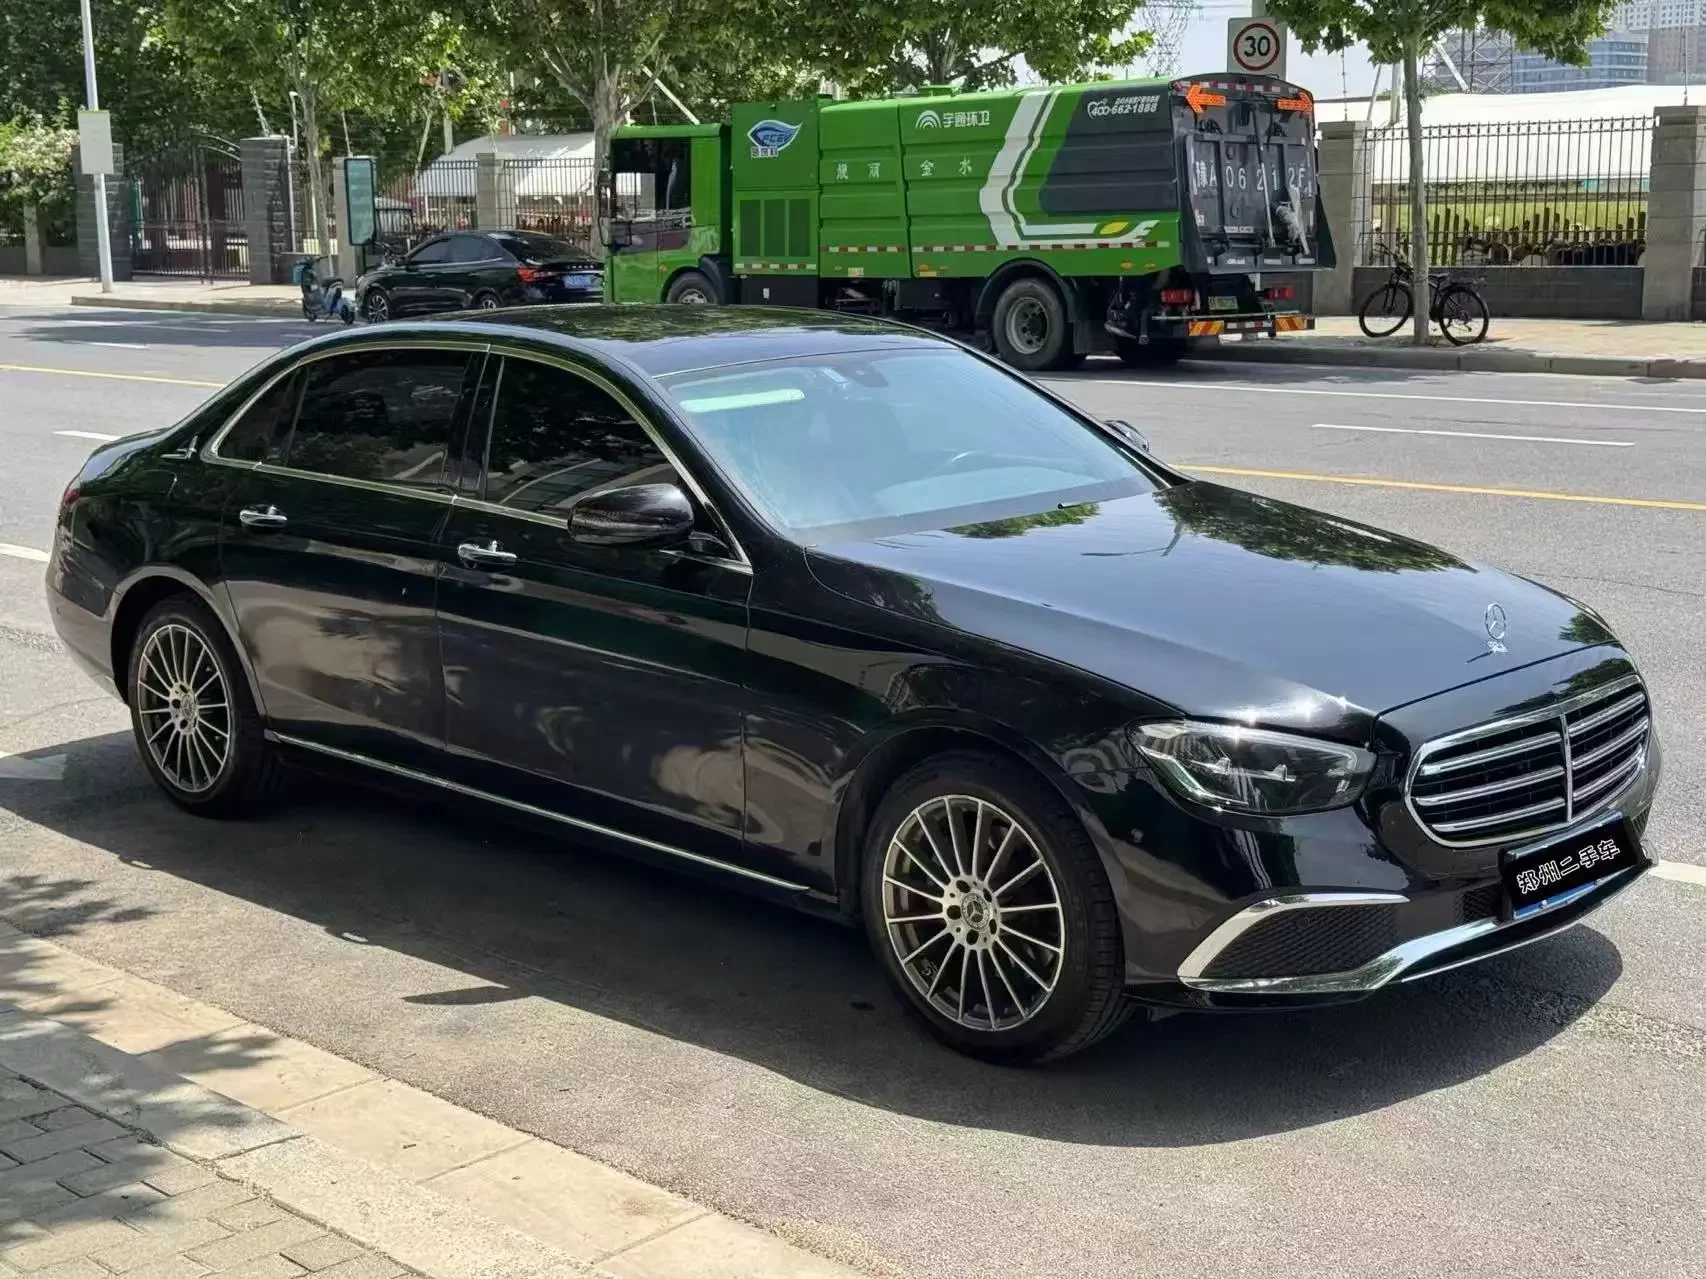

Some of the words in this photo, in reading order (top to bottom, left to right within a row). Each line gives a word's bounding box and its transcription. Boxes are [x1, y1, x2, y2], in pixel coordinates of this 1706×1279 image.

[1244, 36, 1270, 57] 30
[943, 110, 990, 128] 宇通环卫
